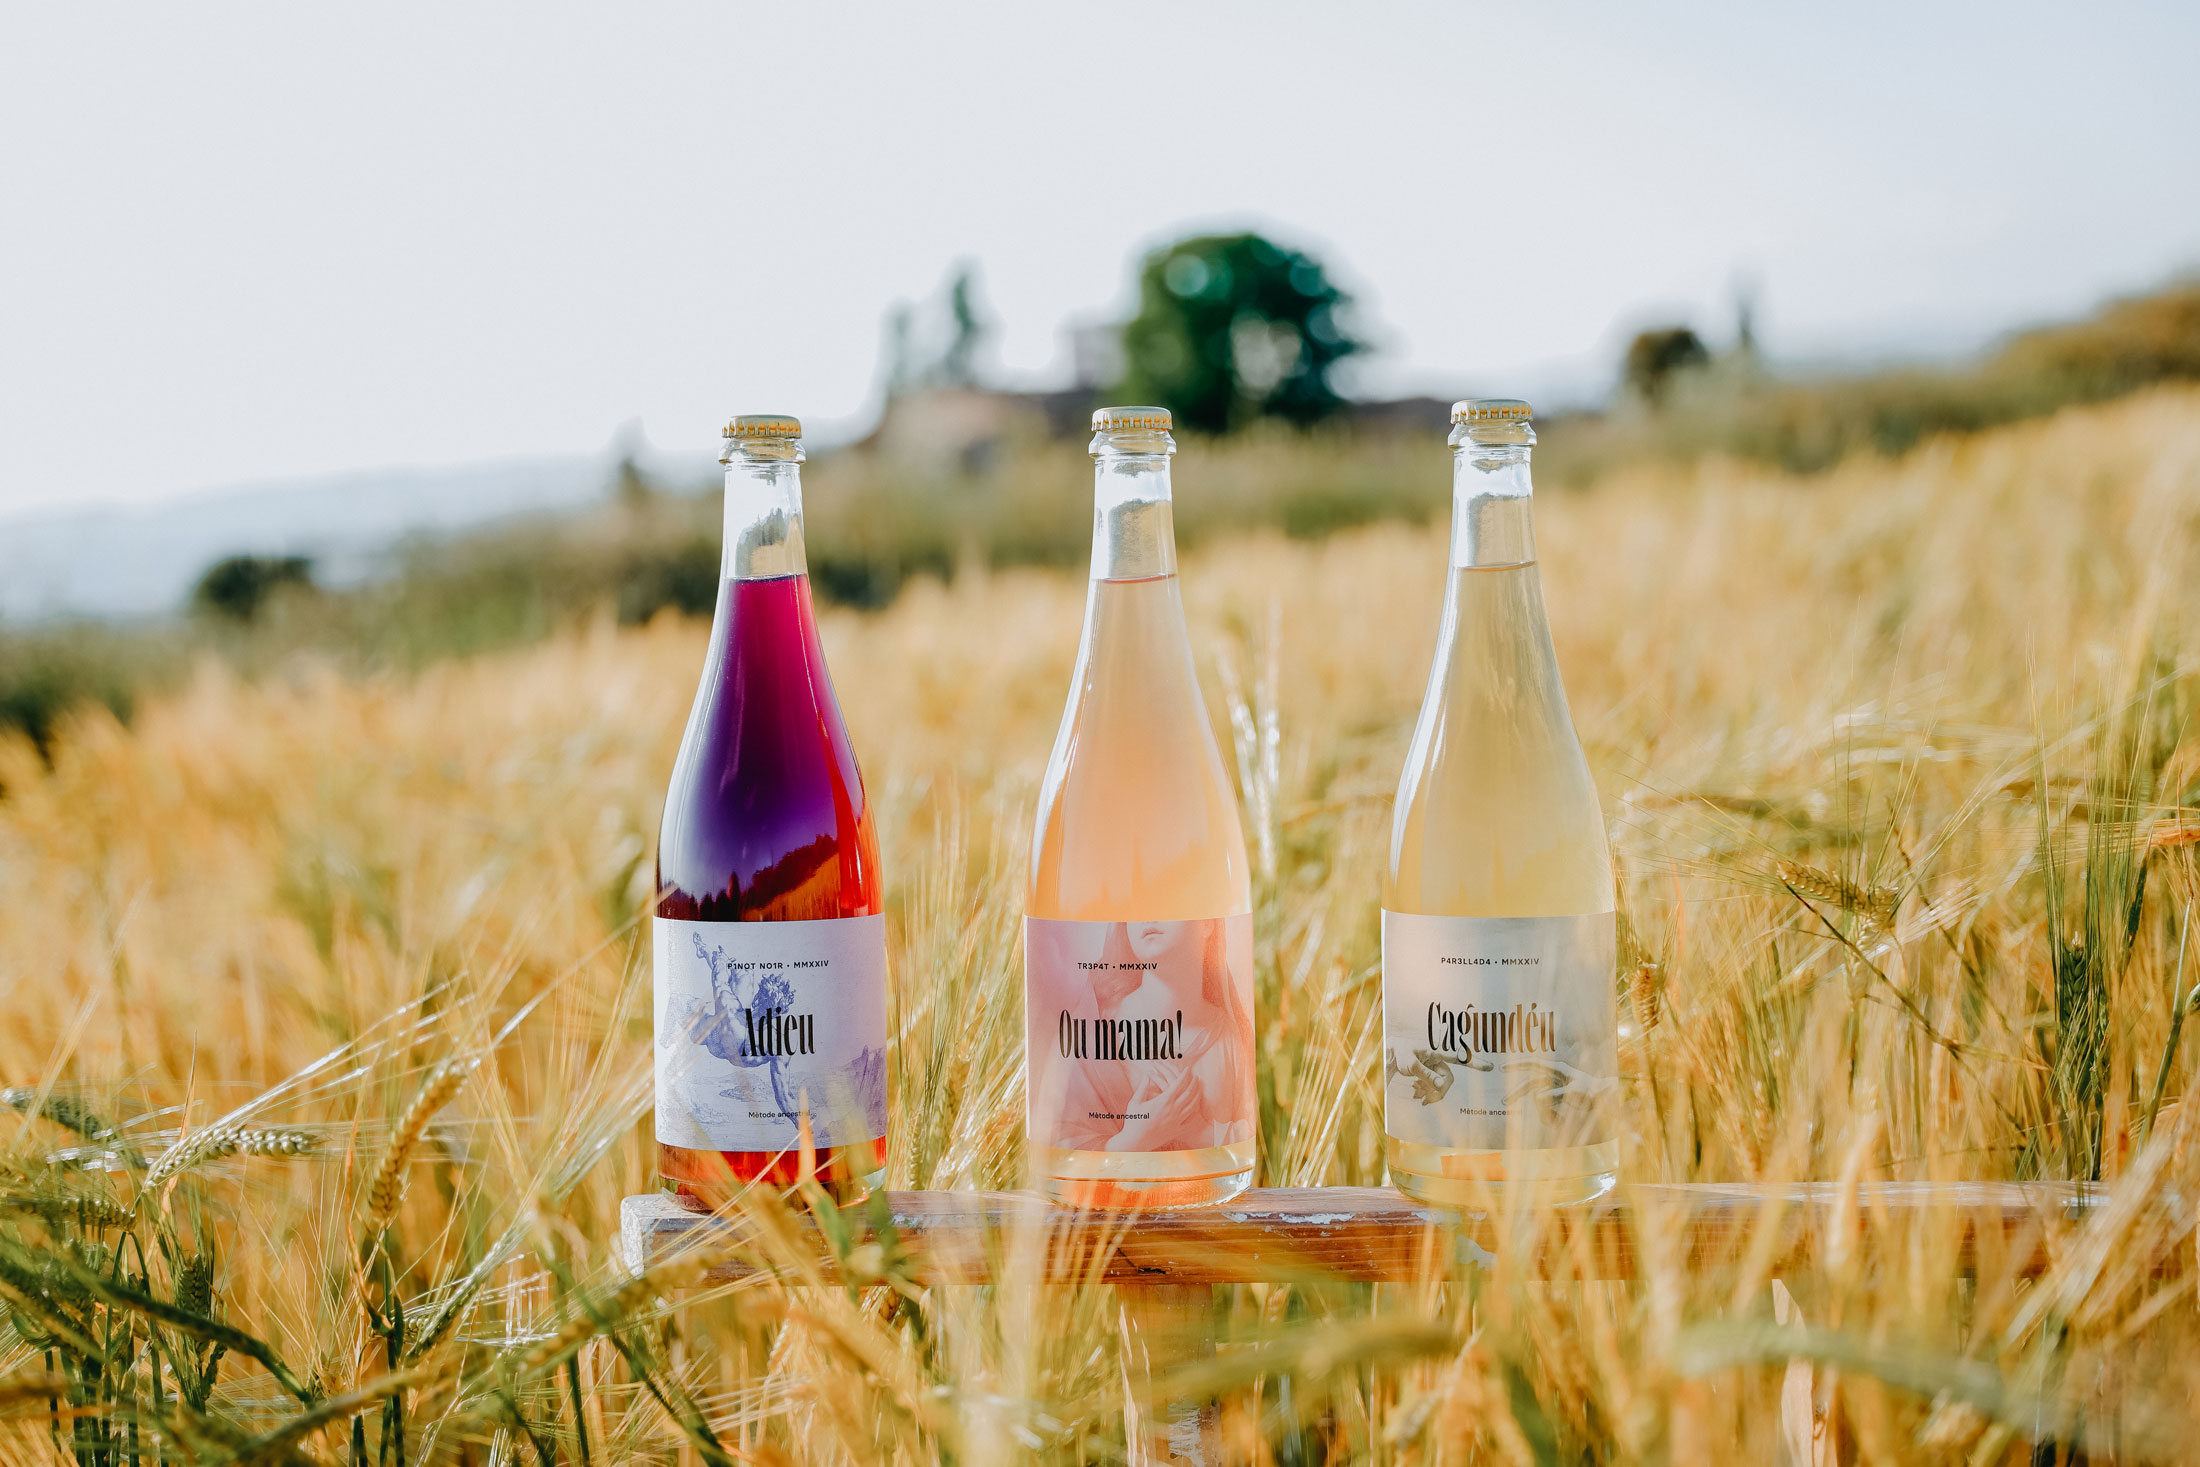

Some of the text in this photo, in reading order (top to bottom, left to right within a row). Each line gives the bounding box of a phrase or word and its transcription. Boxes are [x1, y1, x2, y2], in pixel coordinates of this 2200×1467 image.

[793, 960, 829, 969] MMXXIV
[1441, 957, 1491, 965] P4R3LL4D4
[1077, 962, 1109, 970] TR3P4T
[741, 1006, 816, 1056] Adieu
[1059, 1009, 1183, 1061] Ou mama!
[1116, 1112, 1150, 1120] ancestral
